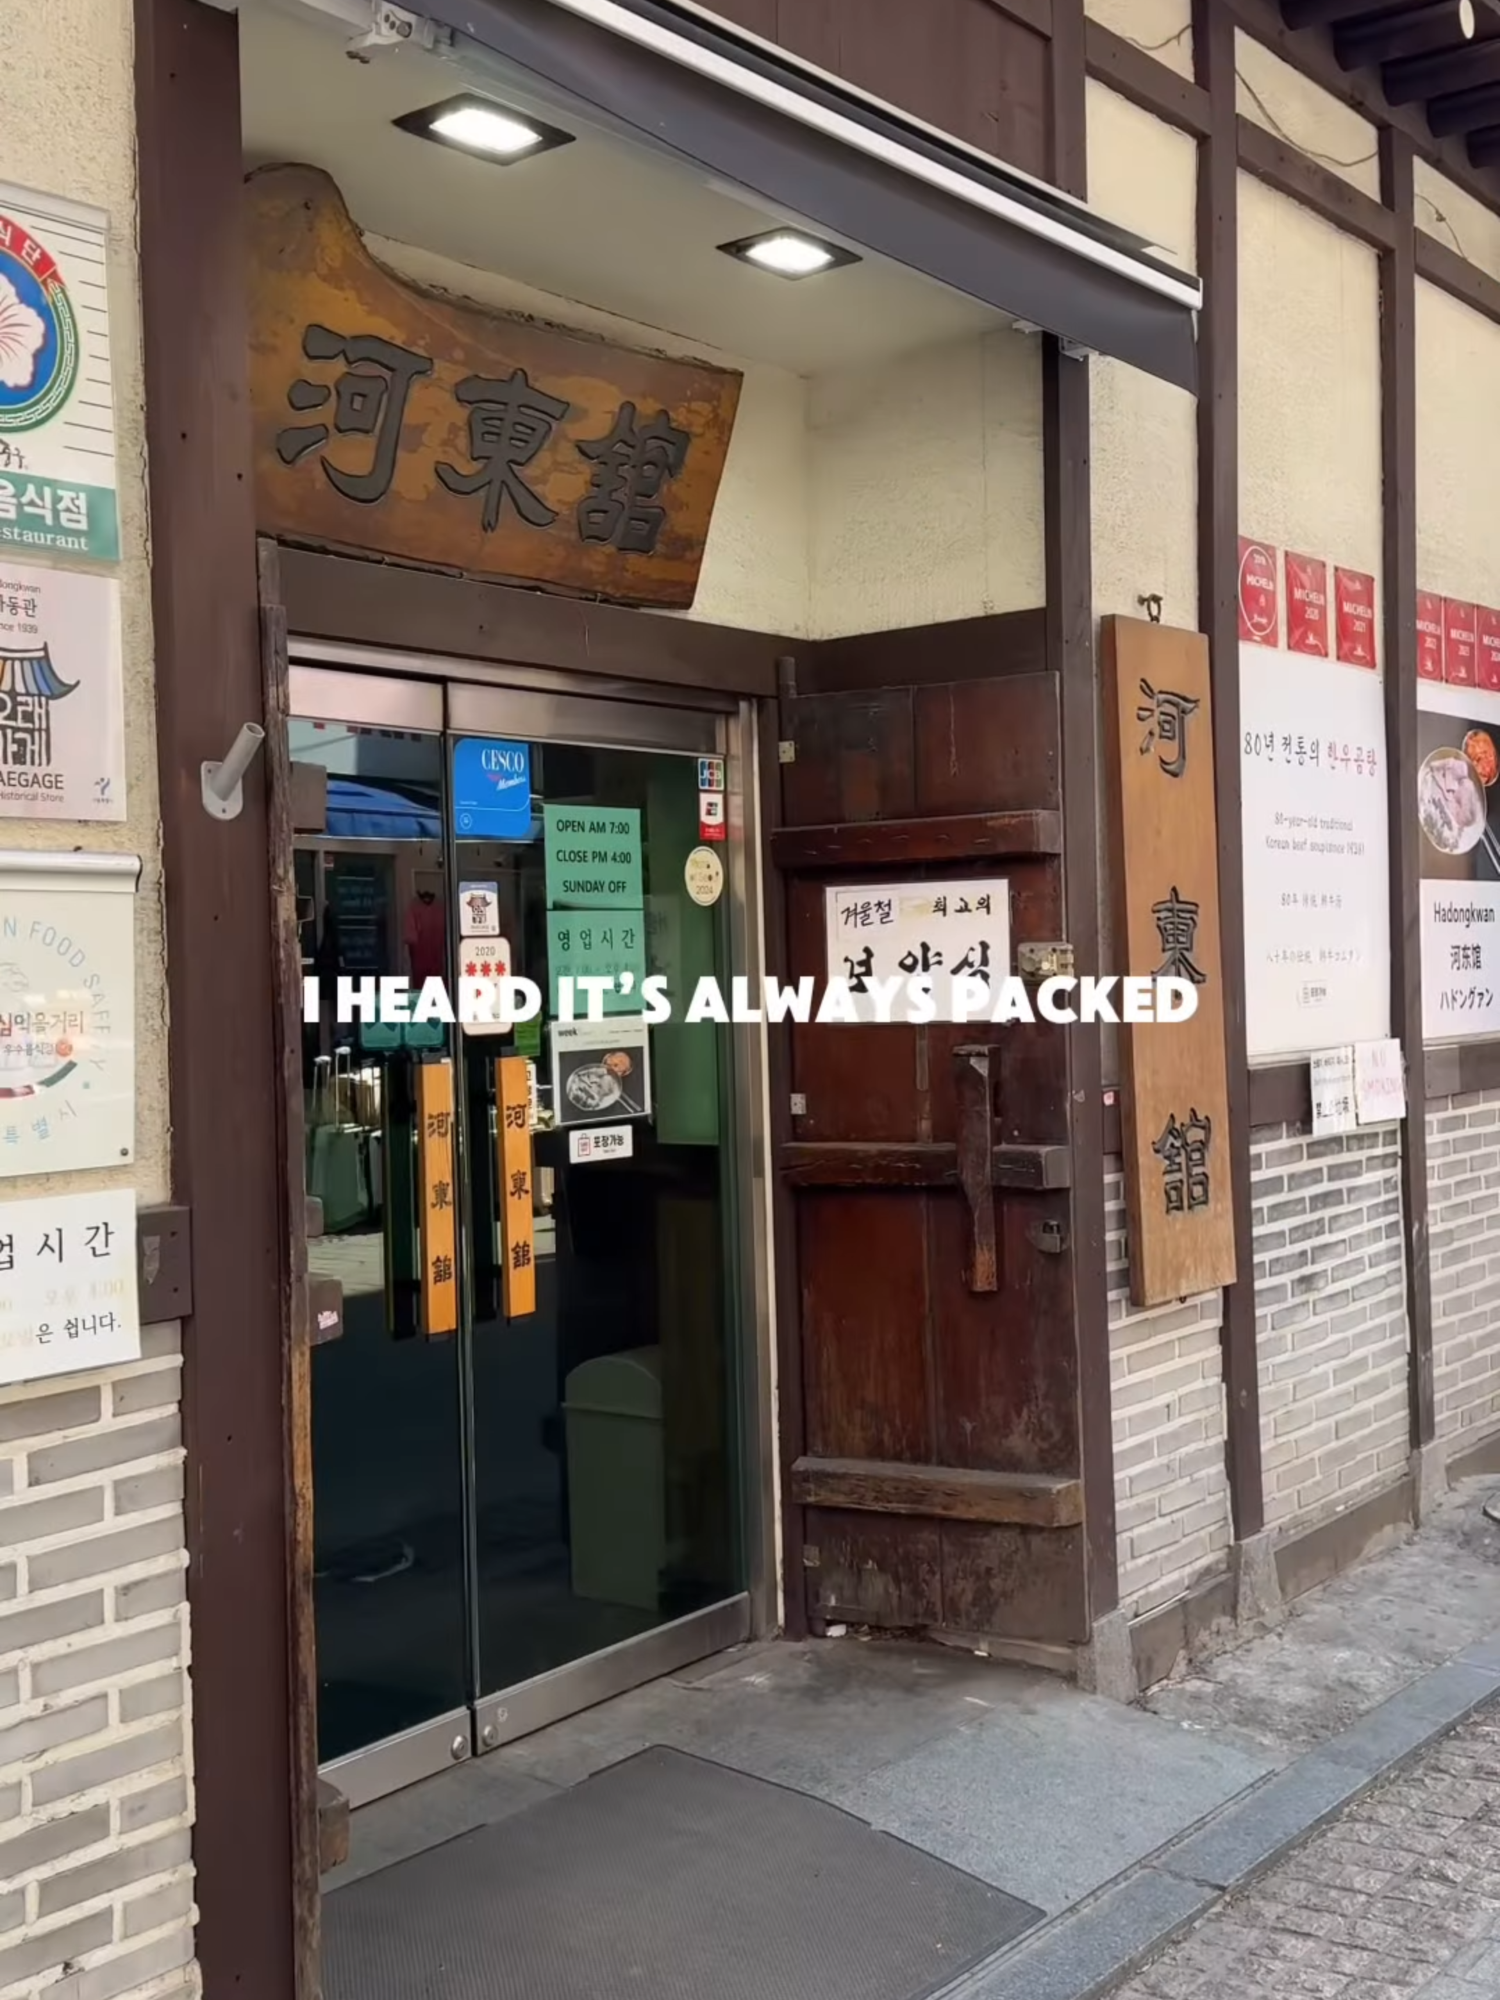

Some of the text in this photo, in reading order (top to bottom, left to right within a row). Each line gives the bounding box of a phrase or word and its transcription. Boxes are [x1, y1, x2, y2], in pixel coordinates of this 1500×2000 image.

[17, 622, 38, 634] 1939
[481, 748, 525, 773] CESCO
[700, 769, 721, 780] JCB
[40, 792, 65, 803] Store
[556, 819, 630, 834] OPEN AM 7:00
[556, 849, 632, 864] CLOSE PM 4:00
[562, 879, 627, 893] SUNDAY OFF
[841, 893, 992, 928] 겨울철 최고의
[1433, 901, 1495, 929] Hadongkwan
[29, 920, 86, 968] FOOD
[475, 946, 496, 957] 2020
[63, 1311, 122, 1340] 쉽니다.
